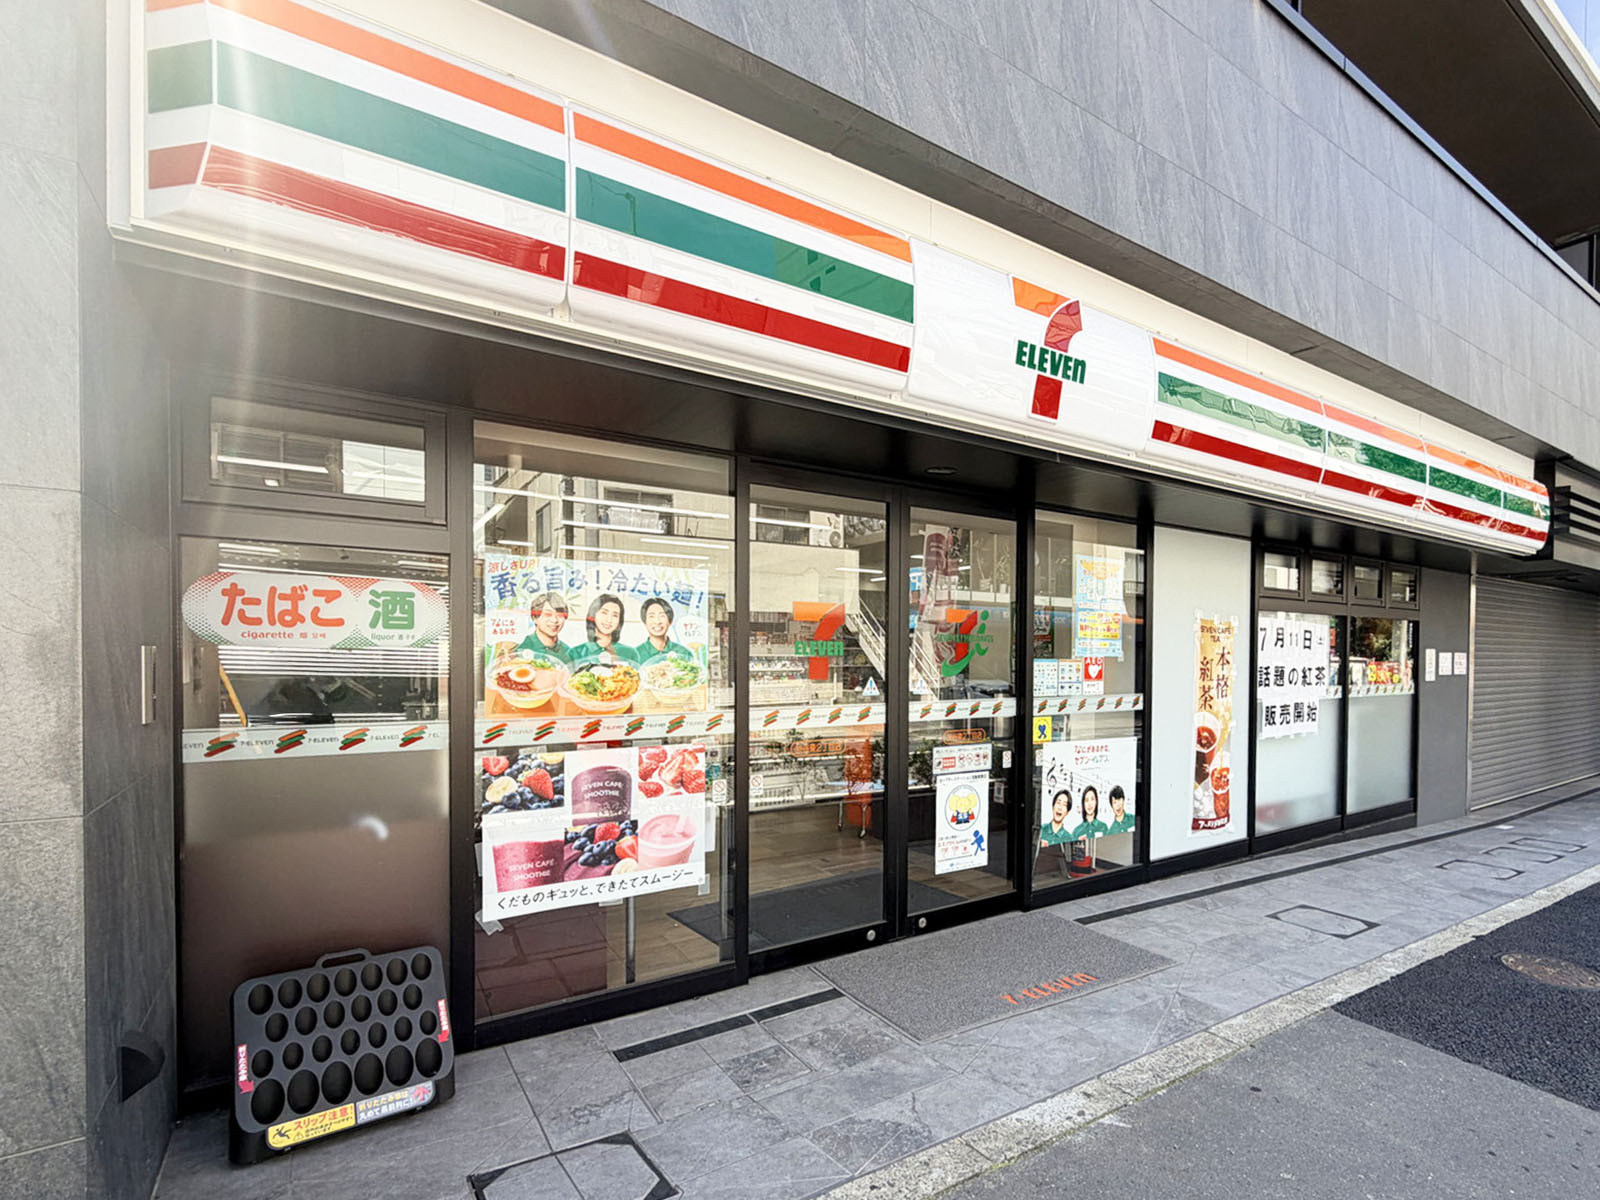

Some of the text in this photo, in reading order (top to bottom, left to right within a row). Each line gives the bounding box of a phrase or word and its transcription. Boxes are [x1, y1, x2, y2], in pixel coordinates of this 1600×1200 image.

[221, 582, 345, 628] たばこ
[369, 589, 416, 630] 酒
[241, 631, 294, 642] cigarette
[371, 633, 396, 641] liquor
[1215, 646, 1231, 699] 本格
[1258, 665, 1326, 687] 話題の紅茶
[1264, 701, 1318, 727] 販売開始
[497, 870, 694, 909] くだものギュッと、できたてスムージー
